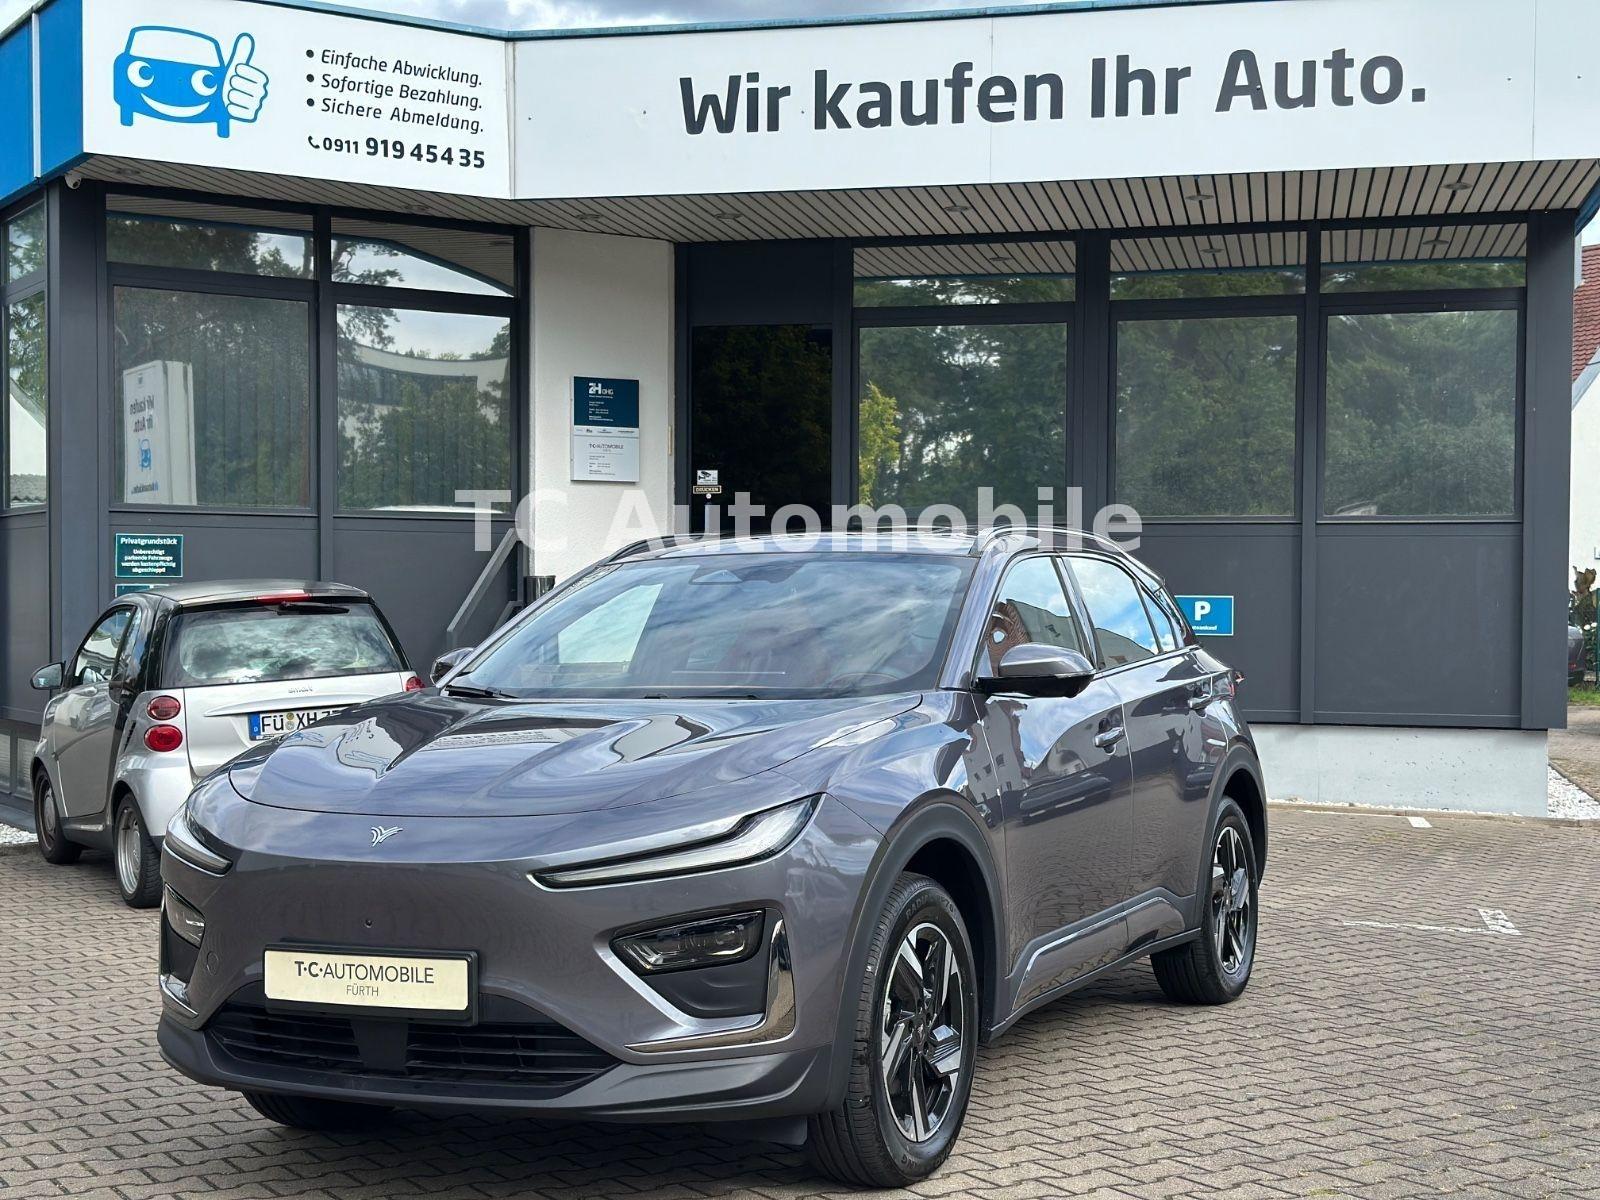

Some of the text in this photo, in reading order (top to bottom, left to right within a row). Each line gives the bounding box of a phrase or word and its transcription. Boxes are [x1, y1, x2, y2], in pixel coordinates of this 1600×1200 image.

[321, 49, 482, 88] Einfache Abwicklung.
[321, 73, 482, 111] Sofortige Bezahlung.
[680, 47, 1427, 136] Wir kaufen Ihr Auto.
[321, 97, 484, 135] Sichere Abmeldung.
[322, 137, 485, 169] 0911 919 454 35
[120, 537, 178, 546] Privatgrundstück
[1194, 600, 1211, 621] P
[261, 714, 284, 733] FÜ
[346, 983, 379, 997] FÜRTH
